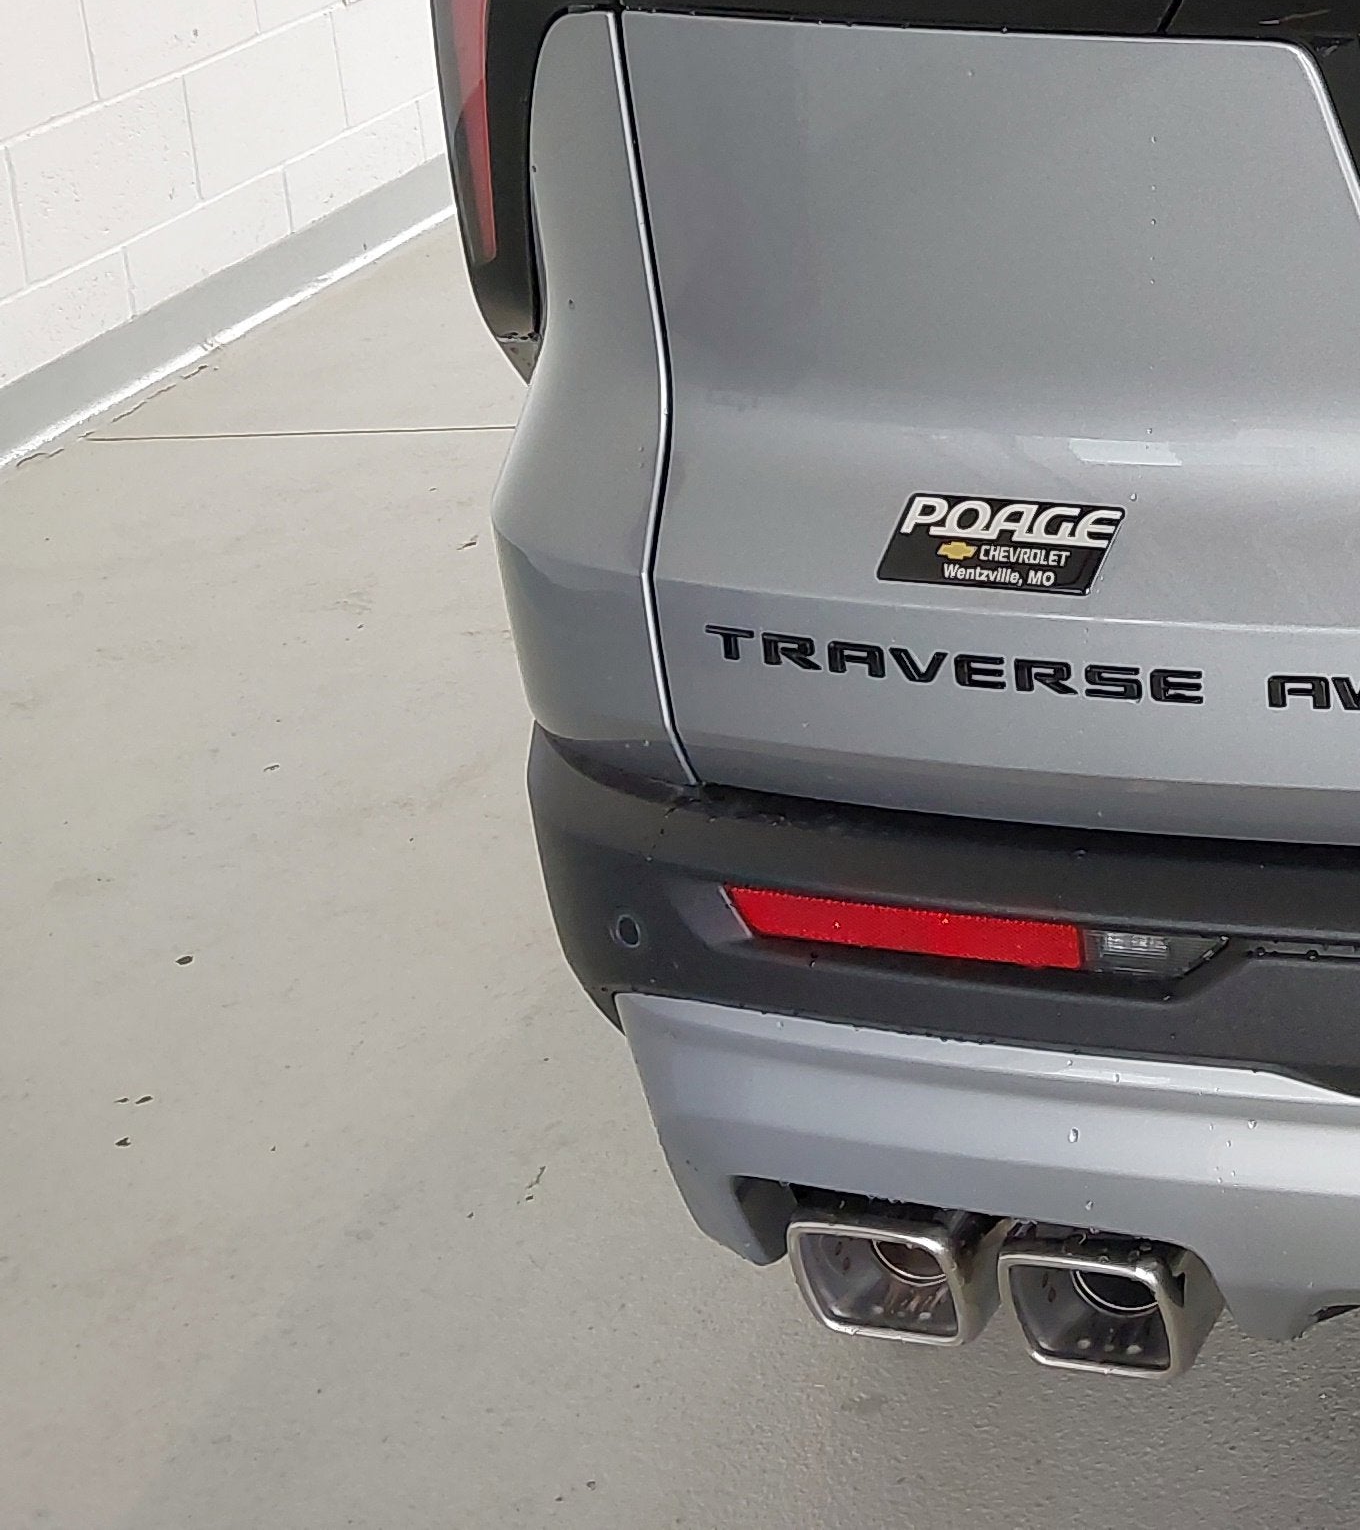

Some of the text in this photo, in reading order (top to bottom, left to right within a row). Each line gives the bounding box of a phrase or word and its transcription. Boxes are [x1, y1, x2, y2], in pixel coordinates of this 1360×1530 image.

[900, 496, 1123, 548] POAGE
[979, 545, 1070, 566] CHEVROLET
[943, 563, 1055, 587] Wentzville, MO
[705, 624, 1205, 705] TRAVERSE
